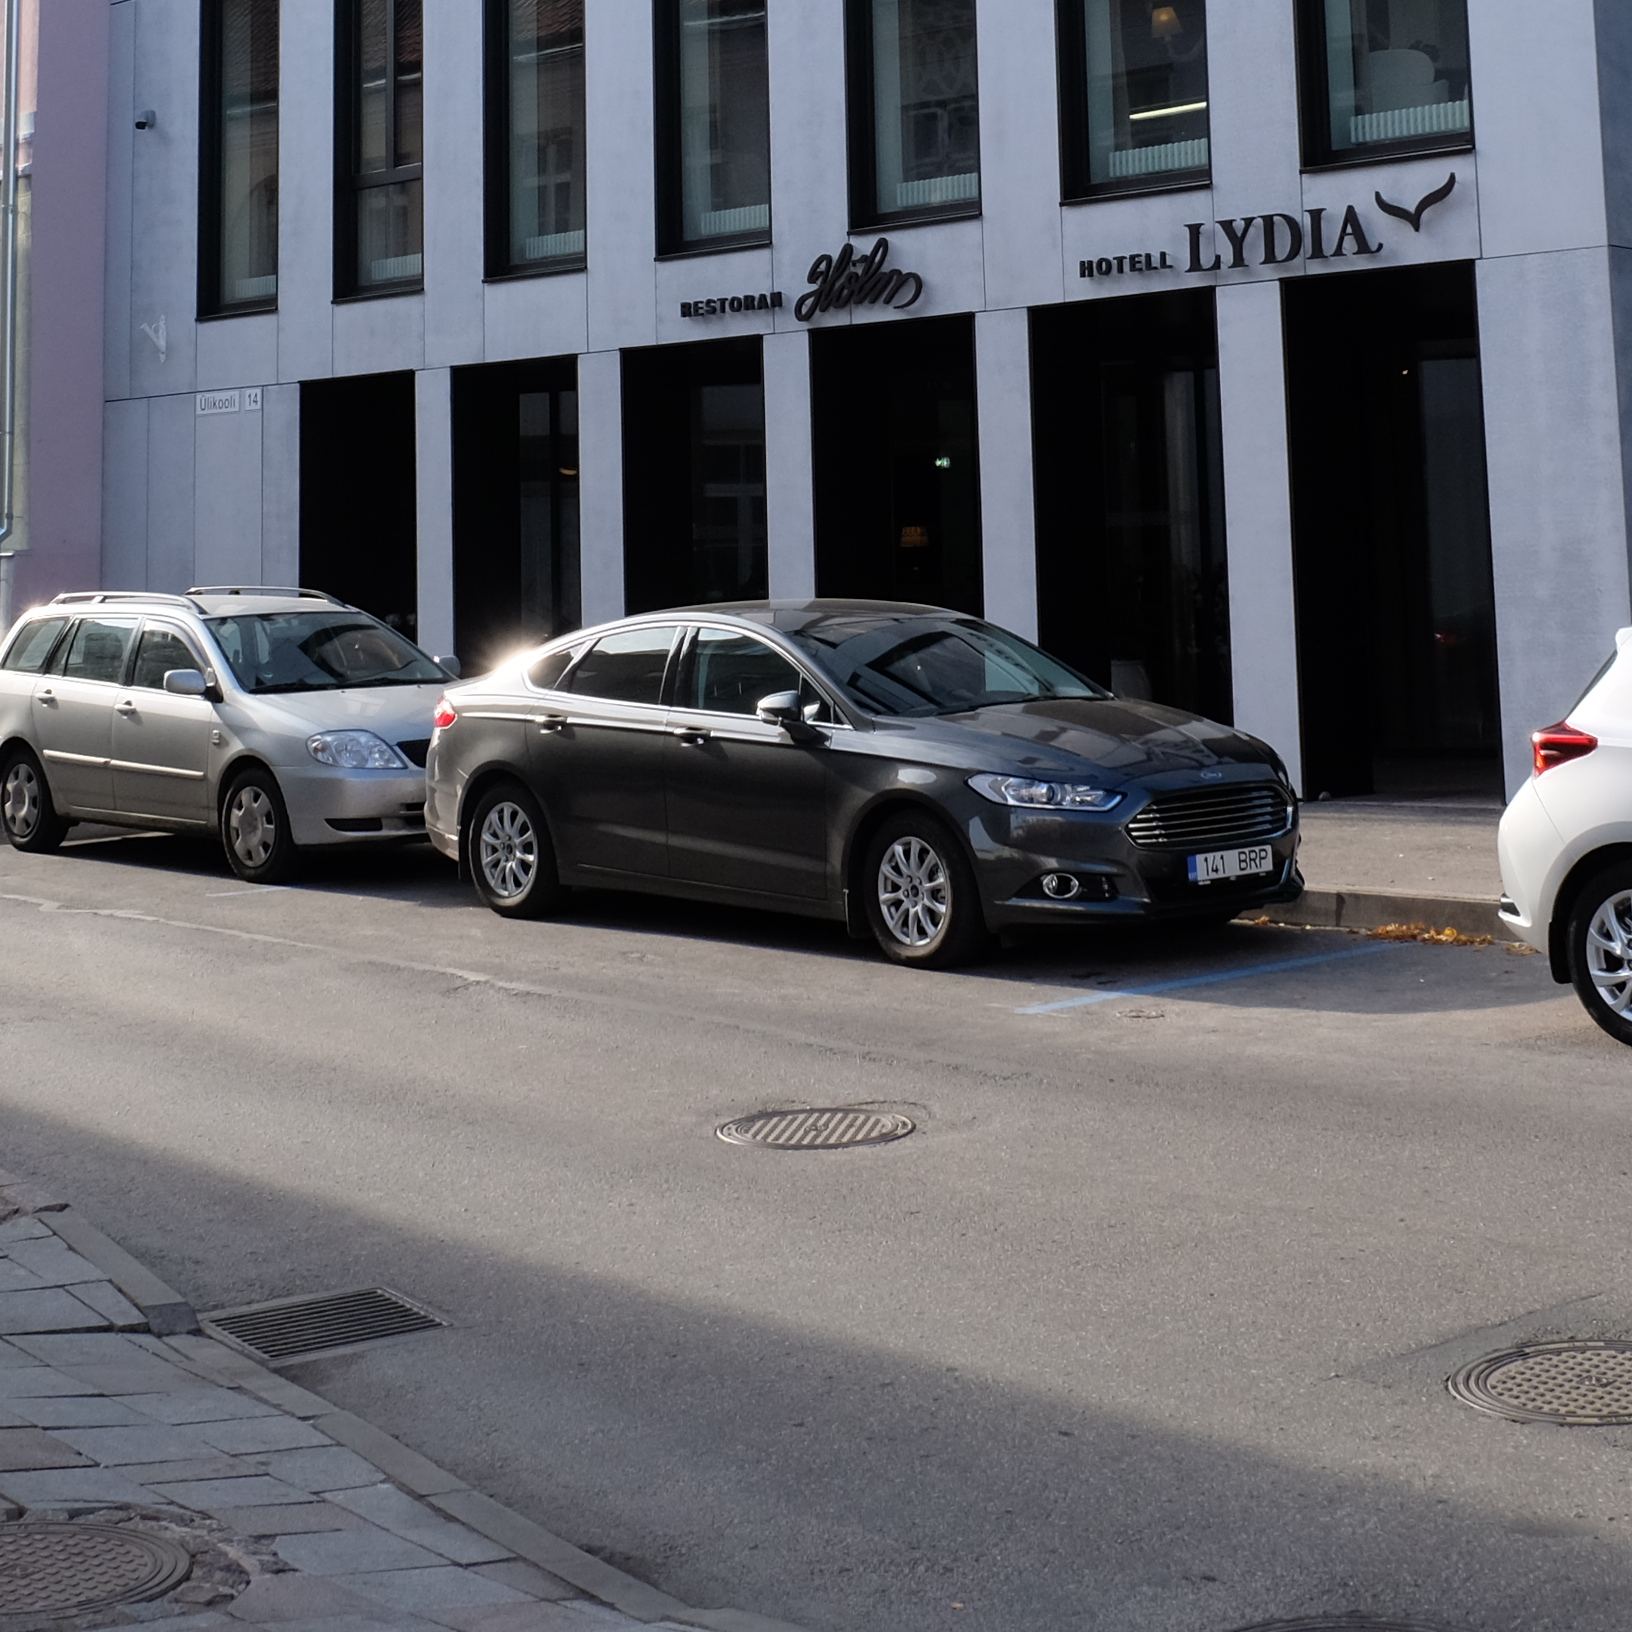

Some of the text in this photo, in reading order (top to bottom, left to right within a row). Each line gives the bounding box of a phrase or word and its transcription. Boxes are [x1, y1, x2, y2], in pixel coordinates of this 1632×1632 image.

[1078, 204, 1384, 279] HOTELL LYDIA
[679, 291, 784, 319] RESTORAN
[199, 393, 258, 411] Ülikooli 14
[1203, 854, 1227, 877] 141
[1238, 849, 1268, 871] BRP
